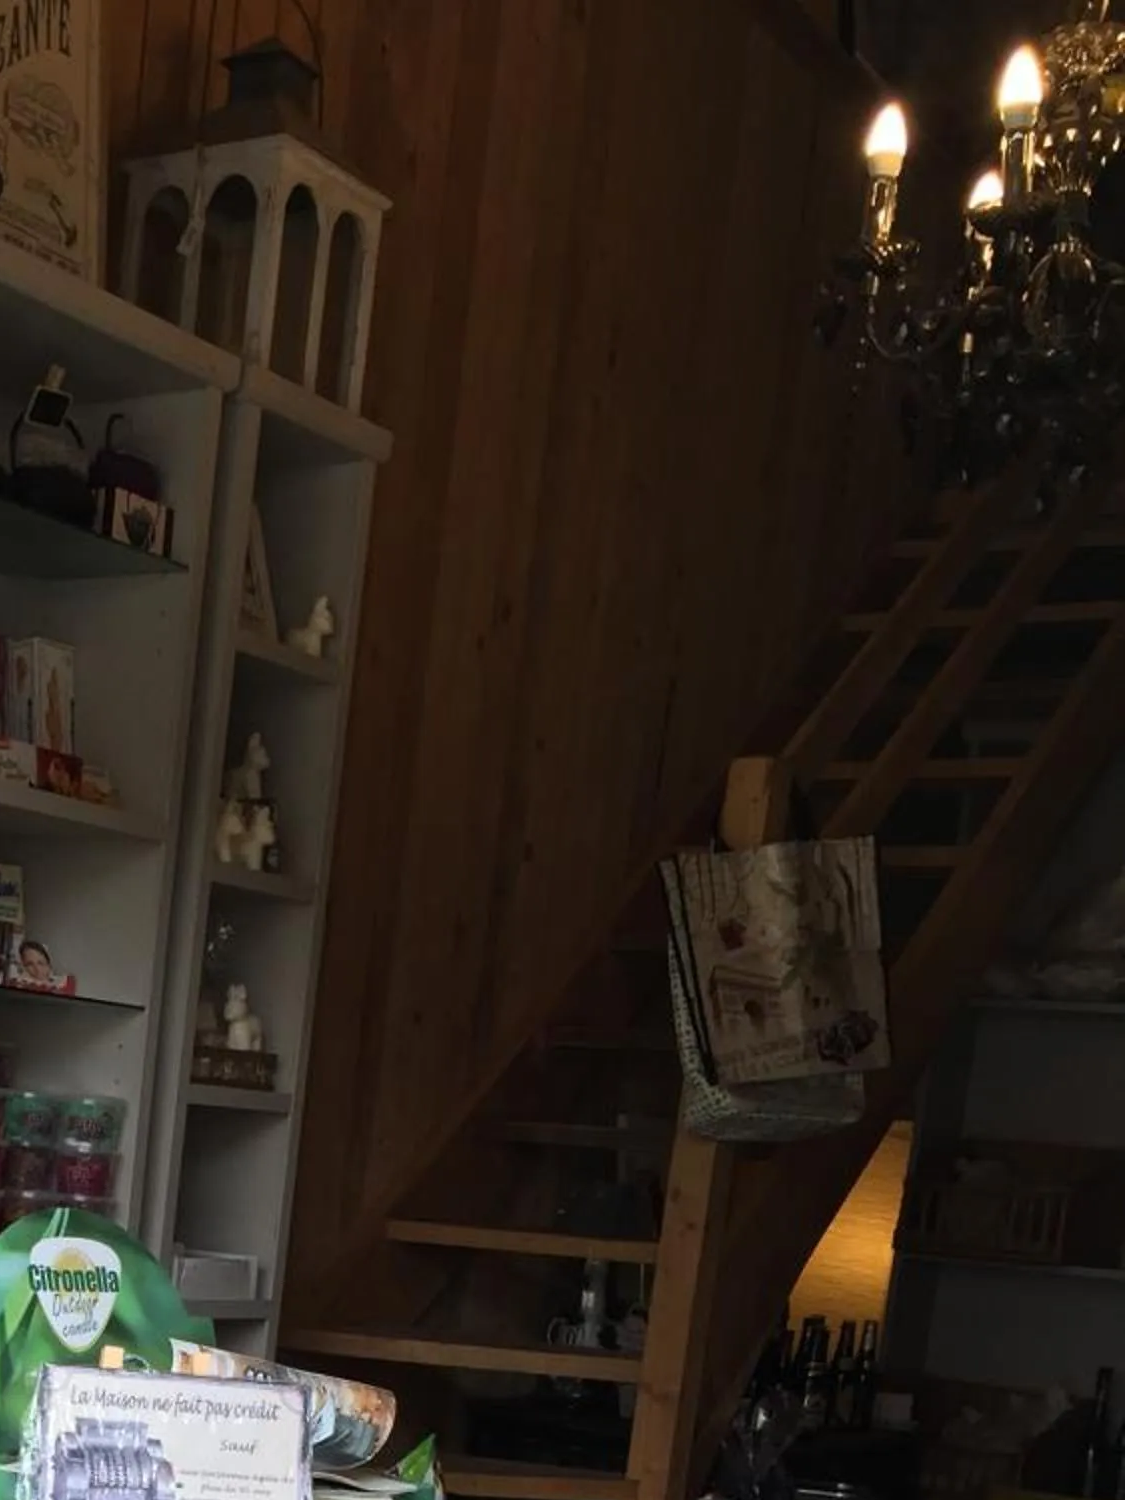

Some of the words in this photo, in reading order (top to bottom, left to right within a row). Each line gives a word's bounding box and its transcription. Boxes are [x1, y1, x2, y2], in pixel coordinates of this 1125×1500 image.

[28, 1264, 120, 1293] Citronella
[71, 1384, 92, 1406] La
[93, 1387, 149, 1411] Maison
[172, 1391, 202, 1417] fait
[232, 1398, 282, 1421] crédit
